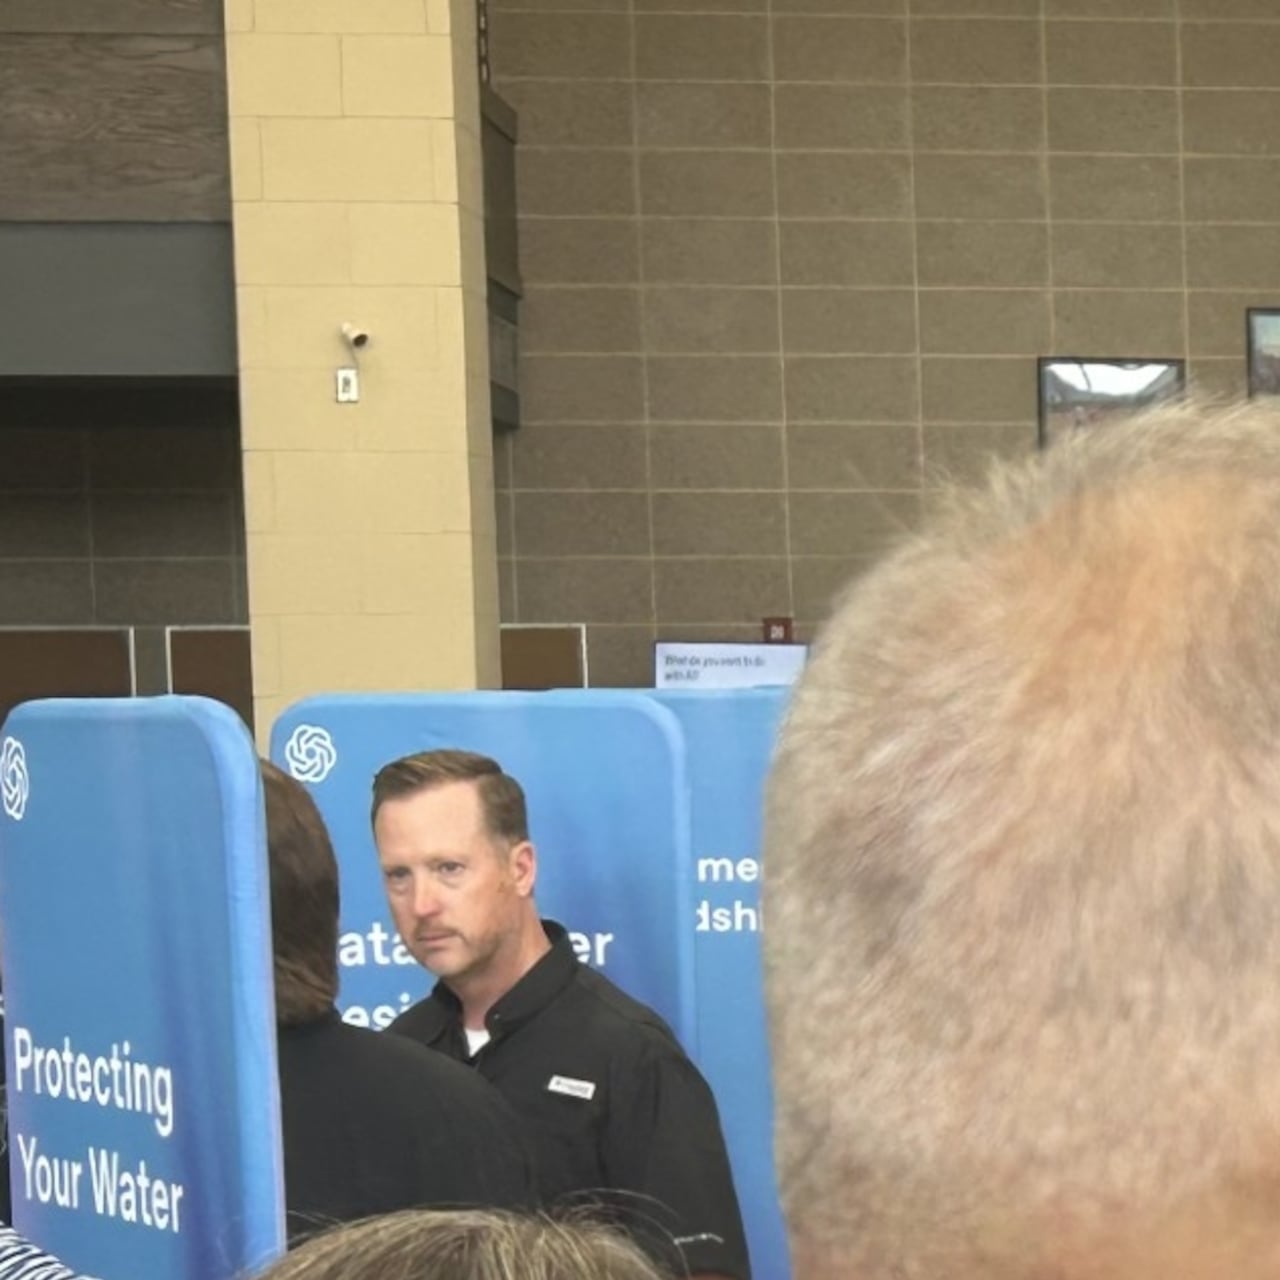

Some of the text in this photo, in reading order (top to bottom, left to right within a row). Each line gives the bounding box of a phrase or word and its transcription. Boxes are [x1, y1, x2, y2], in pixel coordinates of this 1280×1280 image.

[340, 922, 419, 967] ata
[13, 1027, 174, 1137] Protecting
[17, 1133, 183, 1233] Your Water
